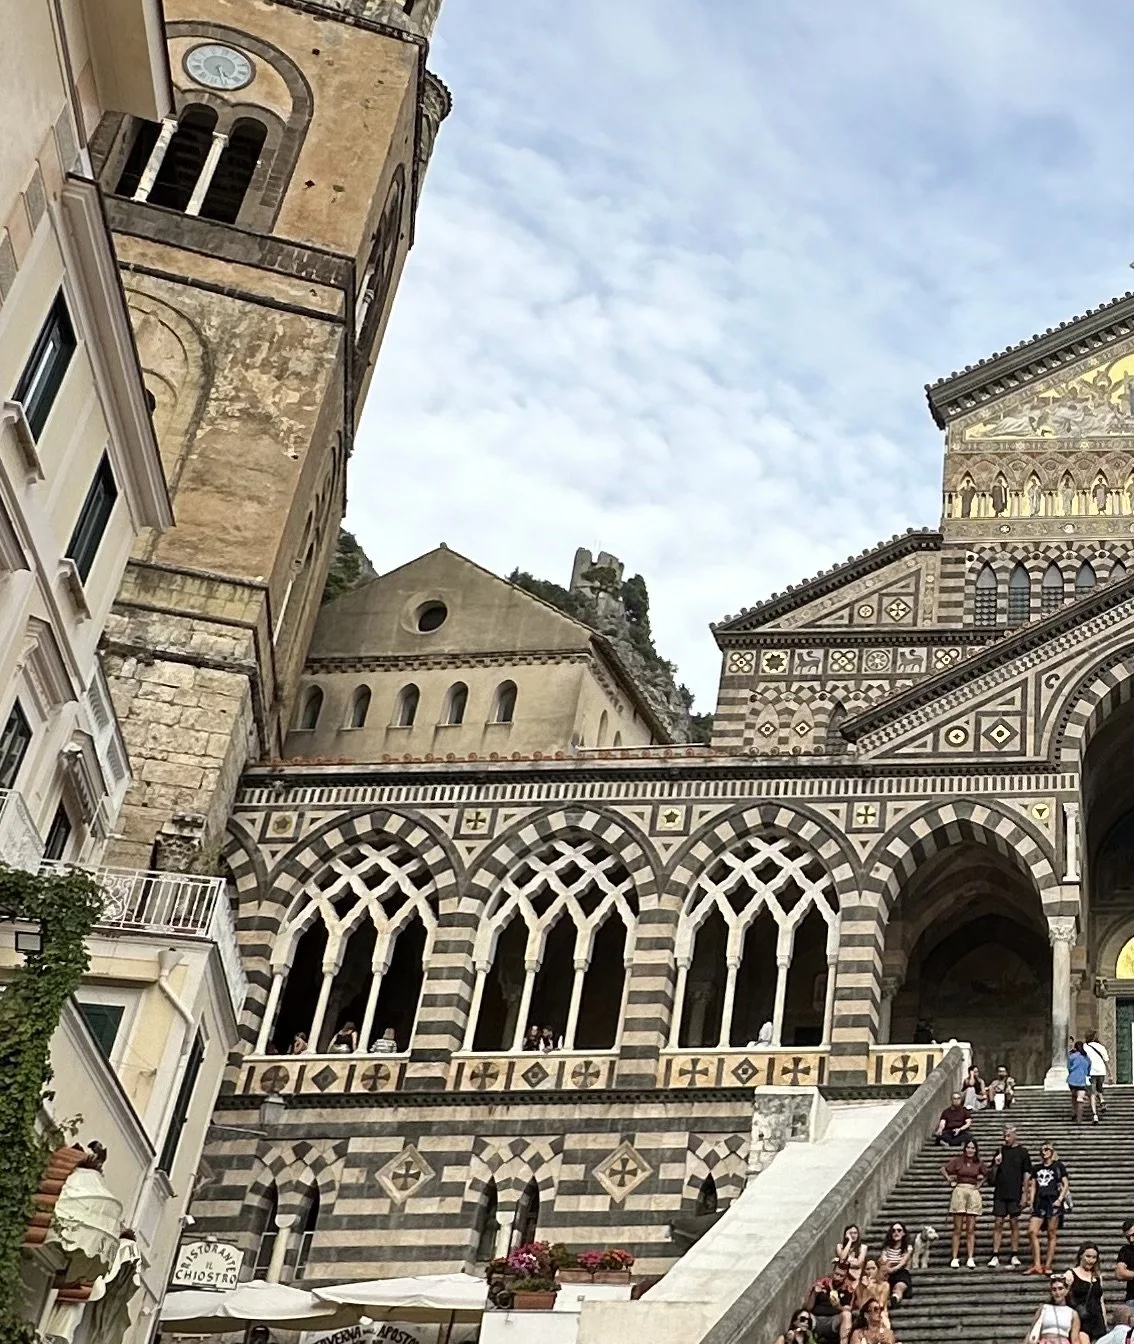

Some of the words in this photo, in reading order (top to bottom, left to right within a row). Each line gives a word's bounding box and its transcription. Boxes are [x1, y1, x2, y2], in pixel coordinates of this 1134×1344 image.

[181, 1243, 236, 1272] RISTORANTE
[205, 1261, 213, 1270] IL
[175, 1269, 237, 1284] CHIOSTRO
